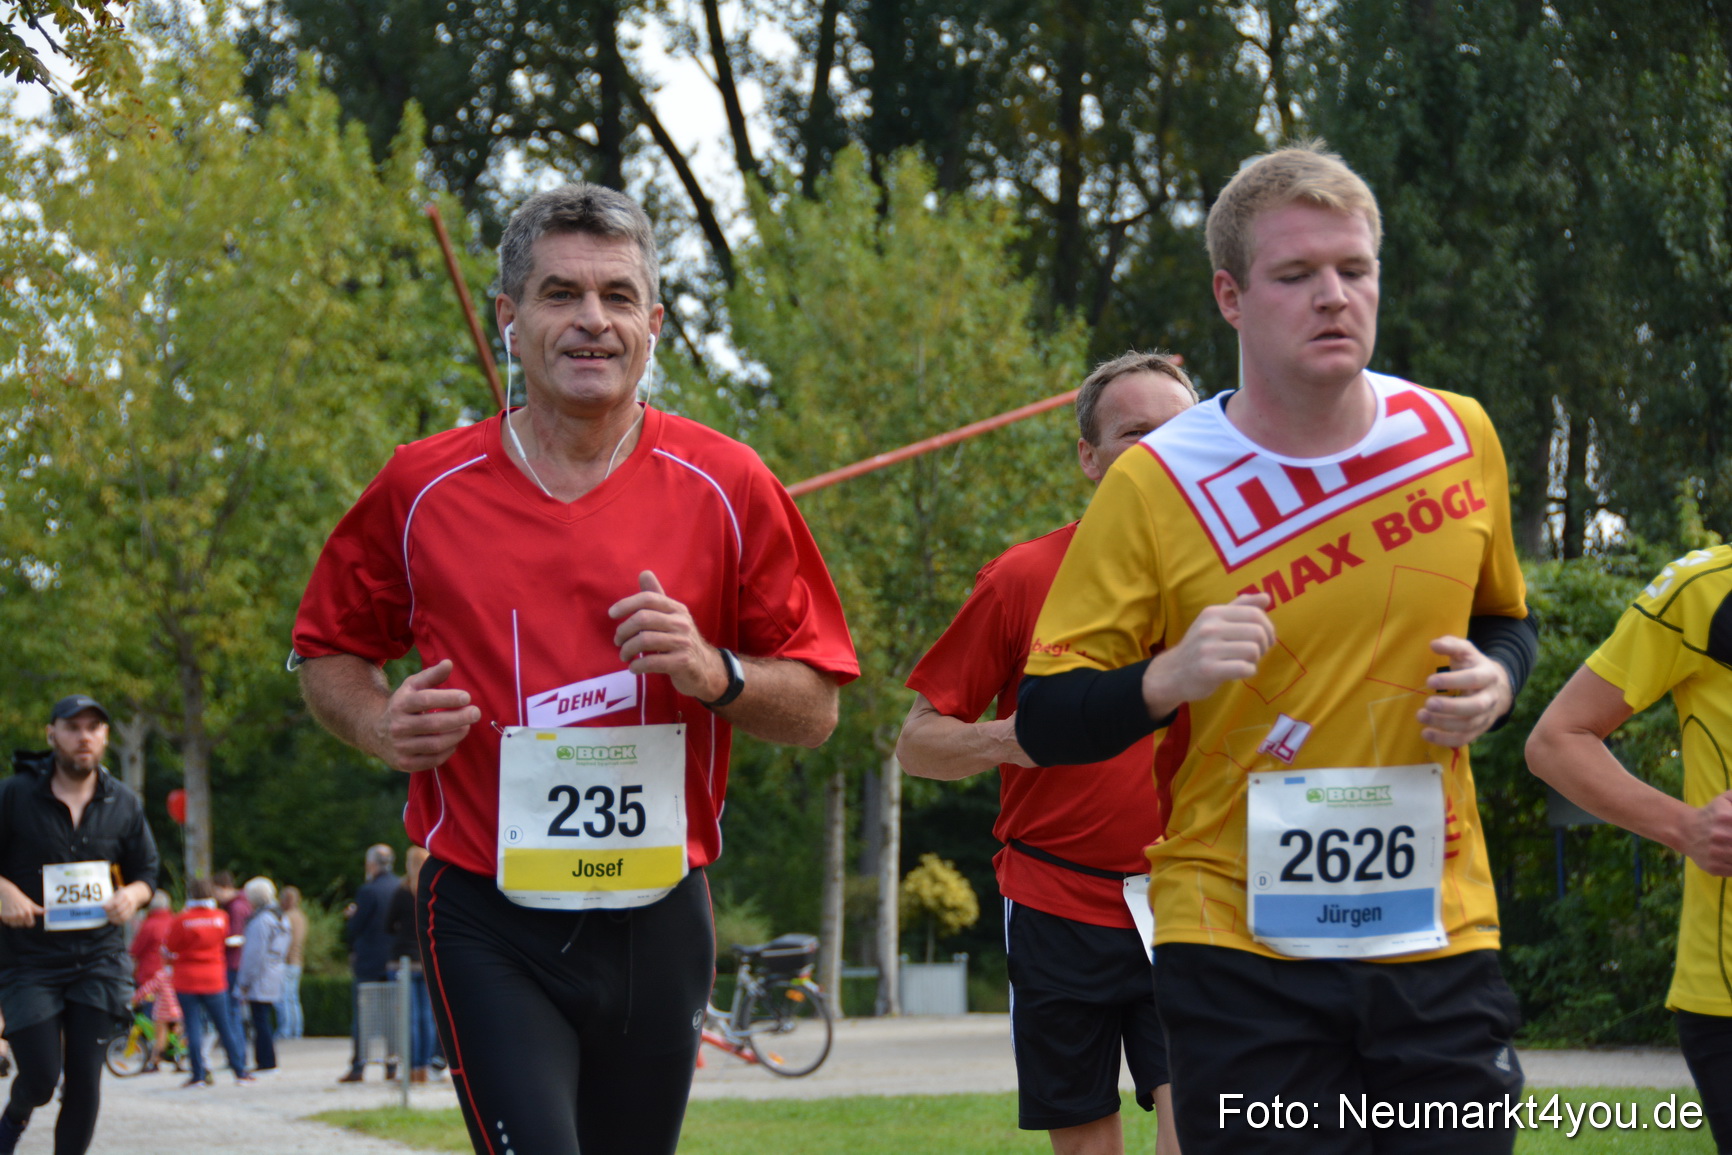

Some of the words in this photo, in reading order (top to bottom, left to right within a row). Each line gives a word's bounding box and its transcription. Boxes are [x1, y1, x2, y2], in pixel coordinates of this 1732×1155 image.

[1236, 531, 1366, 614] MAX
[1371, 479, 1487, 552] BÖGL
[557, 687, 607, 715] DEHN
[576, 745, 637, 760] BOCK
[1327, 785, 1392, 802] BOCK
[547, 784, 646, 838] 235
[510, 830, 517, 840] D
[1279, 825, 1415, 883] 2626
[572, 858, 624, 877] Josef
[55, 883, 103, 904] 2549
[1316, 904, 1382, 928] Jürgen
